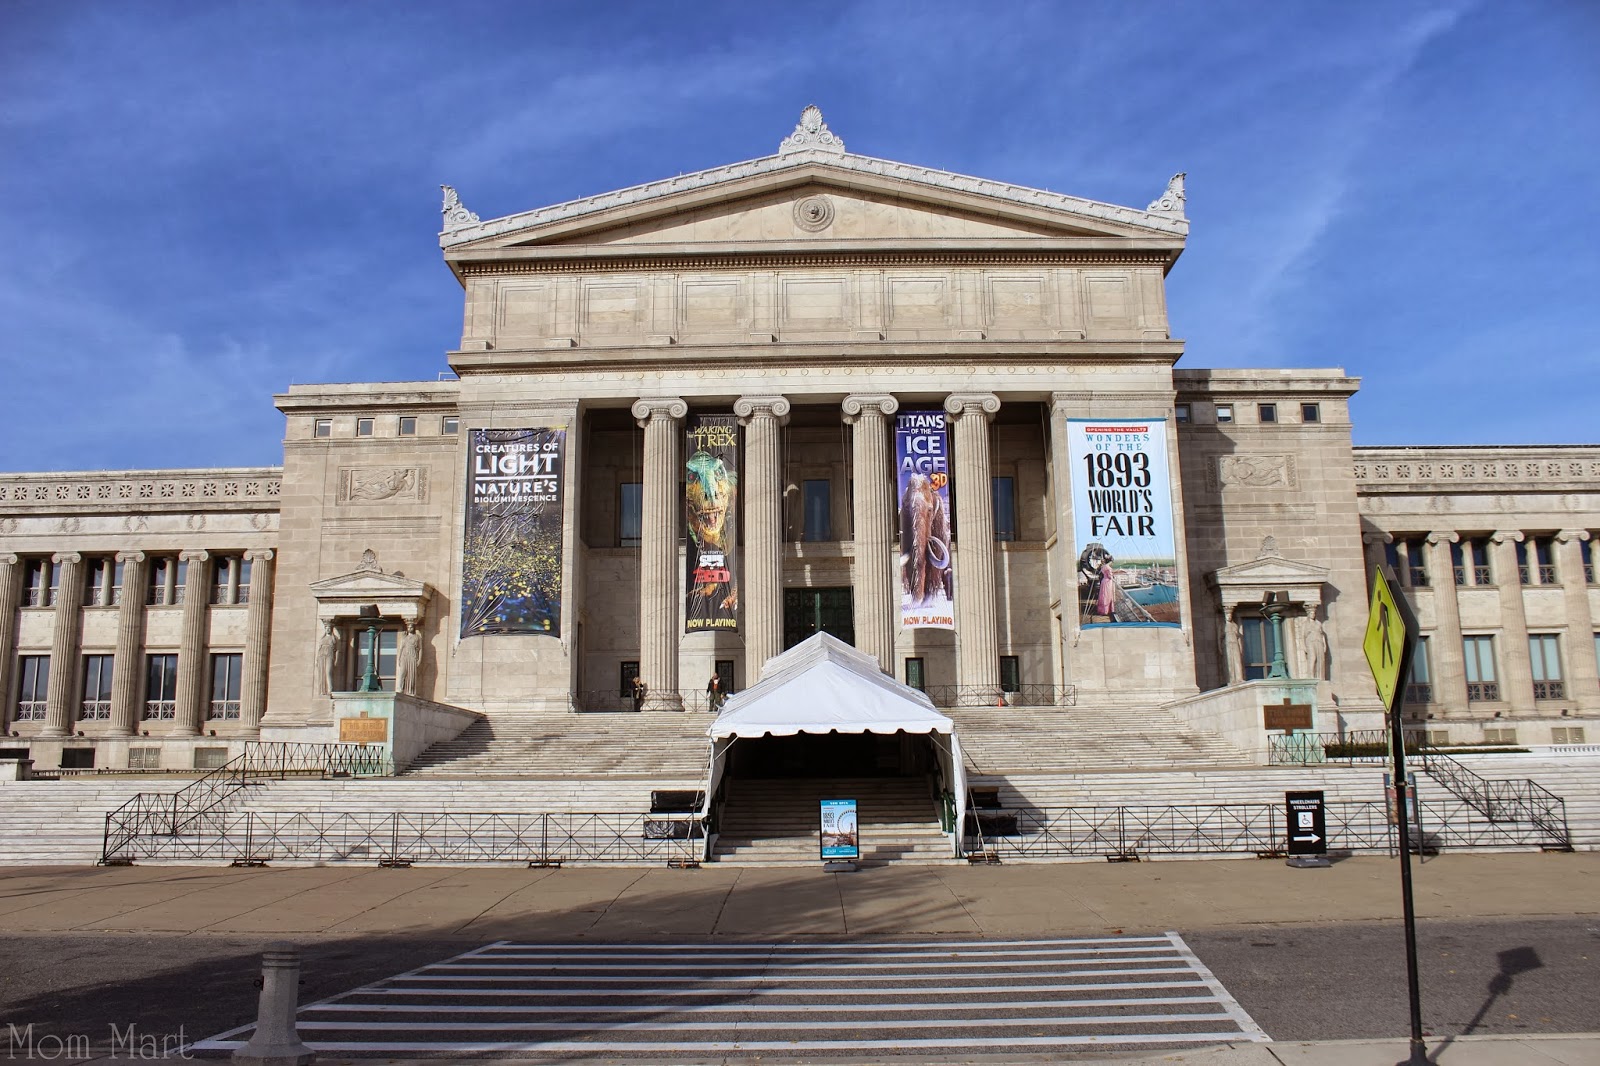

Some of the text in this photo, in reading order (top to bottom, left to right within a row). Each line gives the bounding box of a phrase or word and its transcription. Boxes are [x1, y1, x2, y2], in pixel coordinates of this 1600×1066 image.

[897, 415, 945, 429] TITANS
[694, 425, 733, 434] WAKING
[707, 433, 737, 447] REX
[905, 436, 941, 454] ICE
[1086, 434, 1150, 442] WONDERS
[476, 443, 558, 453] CREATURES OF
[1095, 443, 1142, 451] OF THE
[475, 453, 558, 474] LIGHT
[900, 456, 945, 474] AGE
[1083, 452, 1151, 488] 1893
[474, 480, 557, 494] NATURE'S
[930, 472, 947, 491] 3D
[474, 494, 557, 503] BIOLUMINESCENCE
[1088, 489, 1153, 513] WORLD'S
[1091, 515, 1156, 537] FAIR
[687, 619, 736, 628] NOW PLAYING
[904, 616, 953, 625] NOW PLAYING
